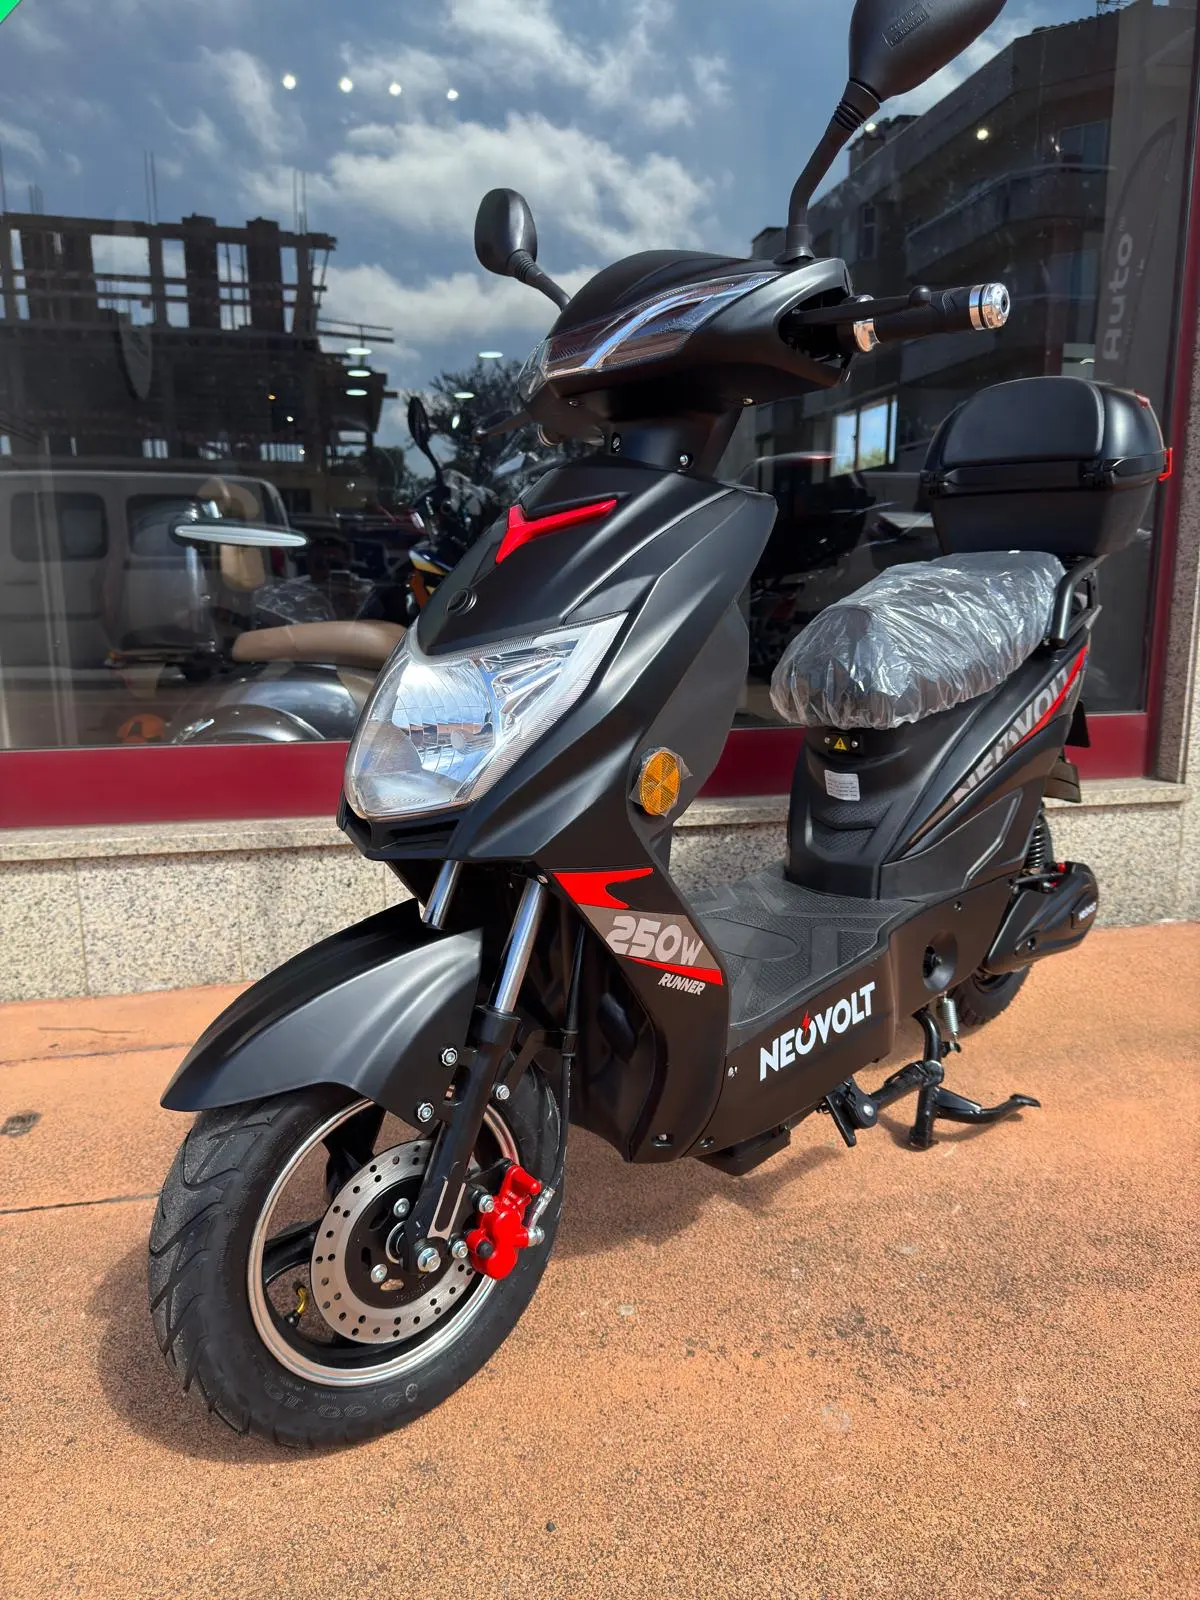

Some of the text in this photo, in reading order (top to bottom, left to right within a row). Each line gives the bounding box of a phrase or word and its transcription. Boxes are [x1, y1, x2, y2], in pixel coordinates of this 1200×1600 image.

[1102, 232, 1134, 361] Auto
[605, 915, 704, 966] 250W
[658, 972, 706, 995] RUNNER
[759, 981, 876, 1081] NEOVOLT
